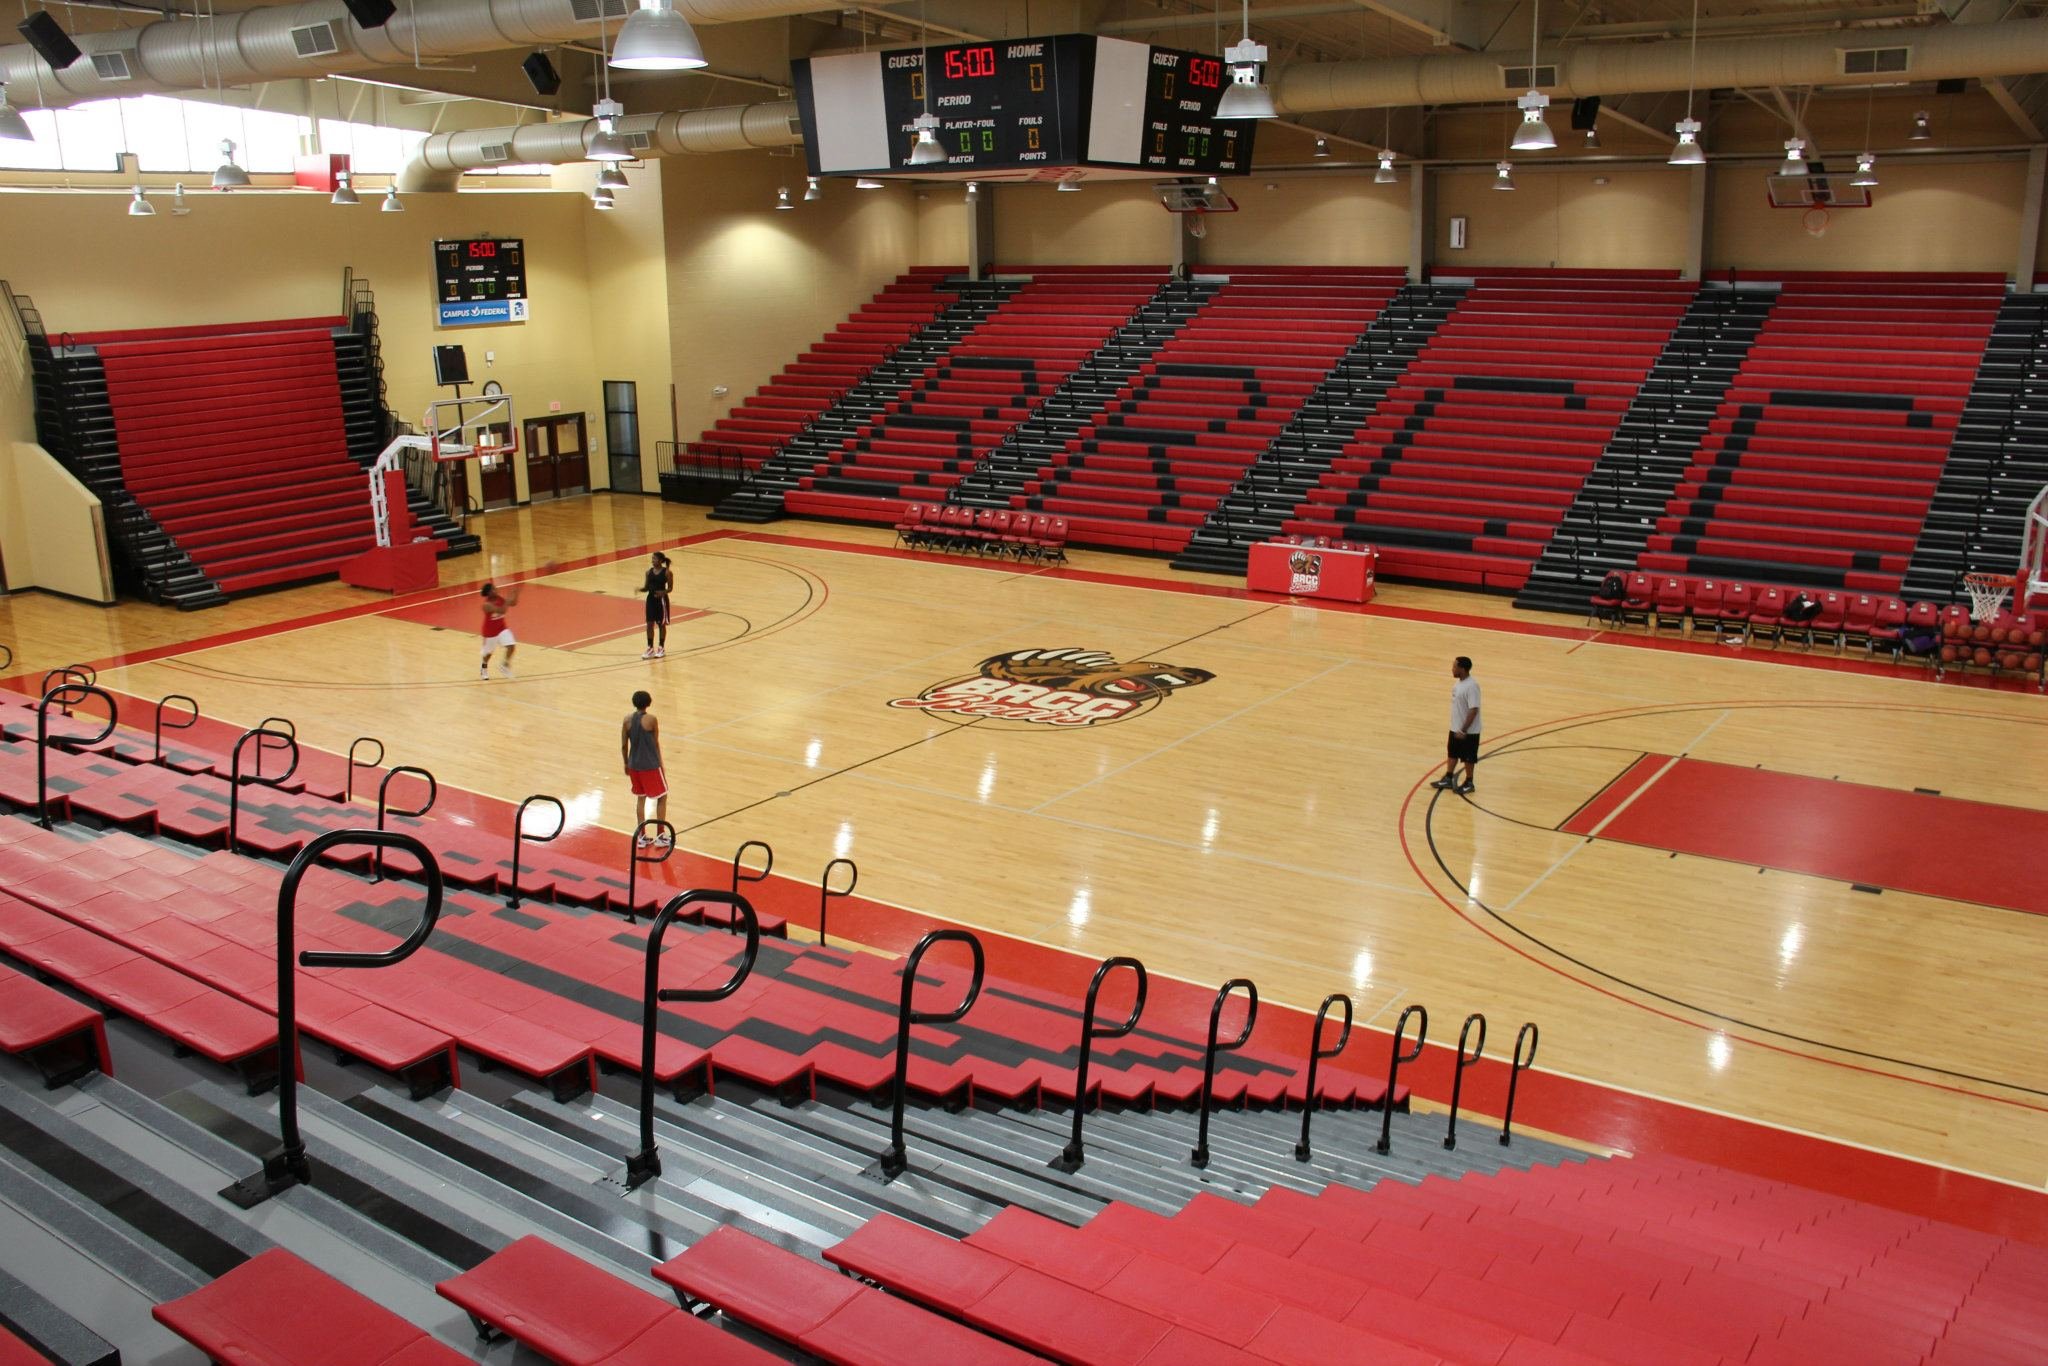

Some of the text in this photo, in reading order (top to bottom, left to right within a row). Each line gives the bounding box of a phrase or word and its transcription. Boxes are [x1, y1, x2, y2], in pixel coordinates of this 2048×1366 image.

[1007, 44, 1044, 59] HOME
[888, 54, 924, 69] GUEST
[945, 47, 995, 79] 15:00
[1153, 52, 1179, 67] GUEST
[1189, 58, 1220, 88] 15:00
[938, 95, 971, 107] PERIOD
[1179, 100, 1201, 112] PERIOD
[1019, 116, 1043, 126] FOULS
[1152, 122, 1168, 131] FOULS
[1223, 129, 1238, 138] FOULS
[948, 155, 975, 164] MATCH
[1019, 151, 1047, 161] POINTS
[1148, 156, 1166, 165] POINTS
[1178, 158, 1195, 166] MATCH
[1219, 161, 1235, 170] POINTS
[439, 243, 459, 251] GUEST
[469, 242, 496, 257] 15:00
[443, 309, 470, 318] CAMPUS
[481, 307, 508, 316] FEDERAL
[1293, 573, 1318, 585] BRCC
[936, 676, 1137, 719] BRCC
